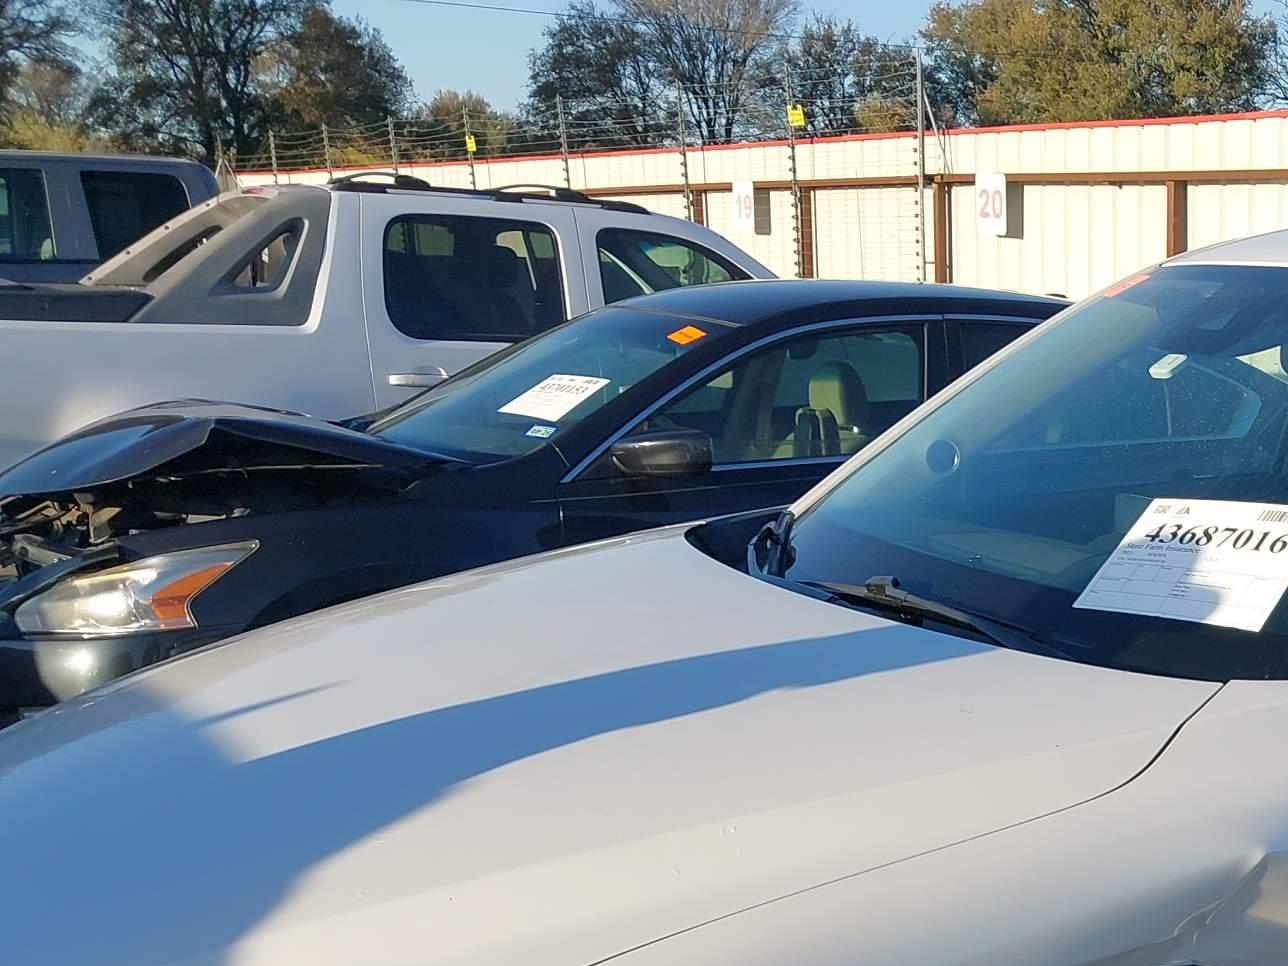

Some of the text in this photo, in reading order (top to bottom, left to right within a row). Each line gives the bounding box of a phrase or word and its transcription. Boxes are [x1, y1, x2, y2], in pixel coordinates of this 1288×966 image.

[736, 194, 751, 219] 19
[978, 189, 1003, 219] 20
[1145, 543, 1165, 552] Farm
[1164, 544, 1204, 554] Insurance
